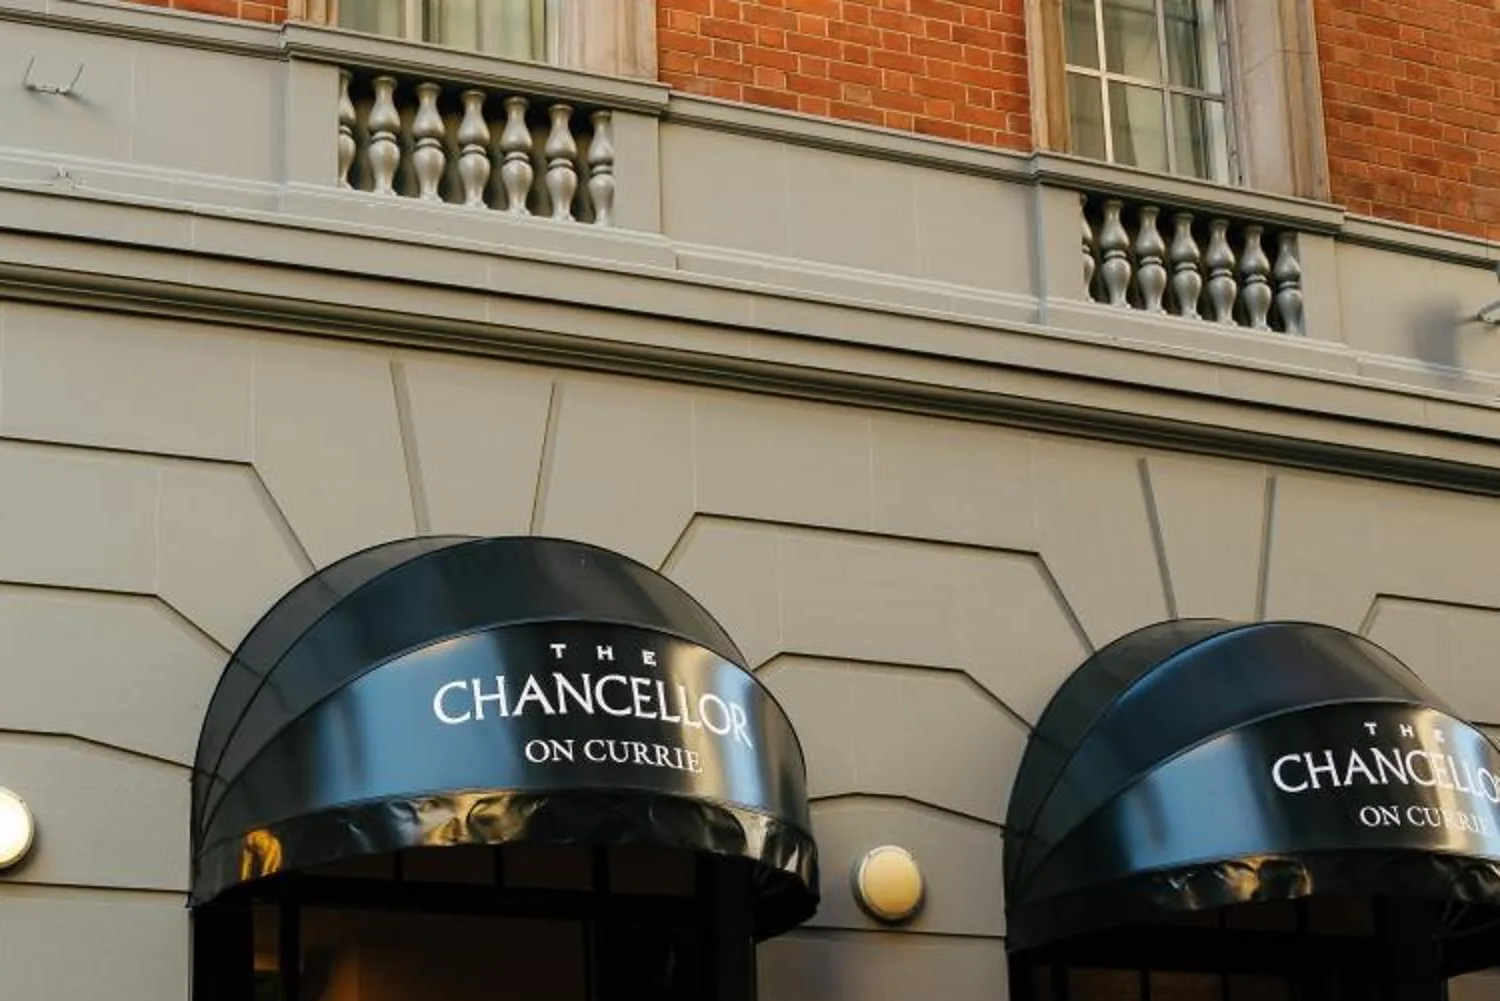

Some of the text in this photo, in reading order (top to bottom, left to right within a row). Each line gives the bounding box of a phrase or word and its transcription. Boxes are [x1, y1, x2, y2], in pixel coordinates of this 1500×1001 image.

[550, 643, 657, 667] THE
[433, 672, 754, 749] CHANCELLOR
[1364, 721, 1445, 743] THE
[525, 739, 704, 774] ON CURRIE
[1272, 748, 1500, 803] CHANCELLO
[1360, 806, 1492, 837] ON CURRIE
